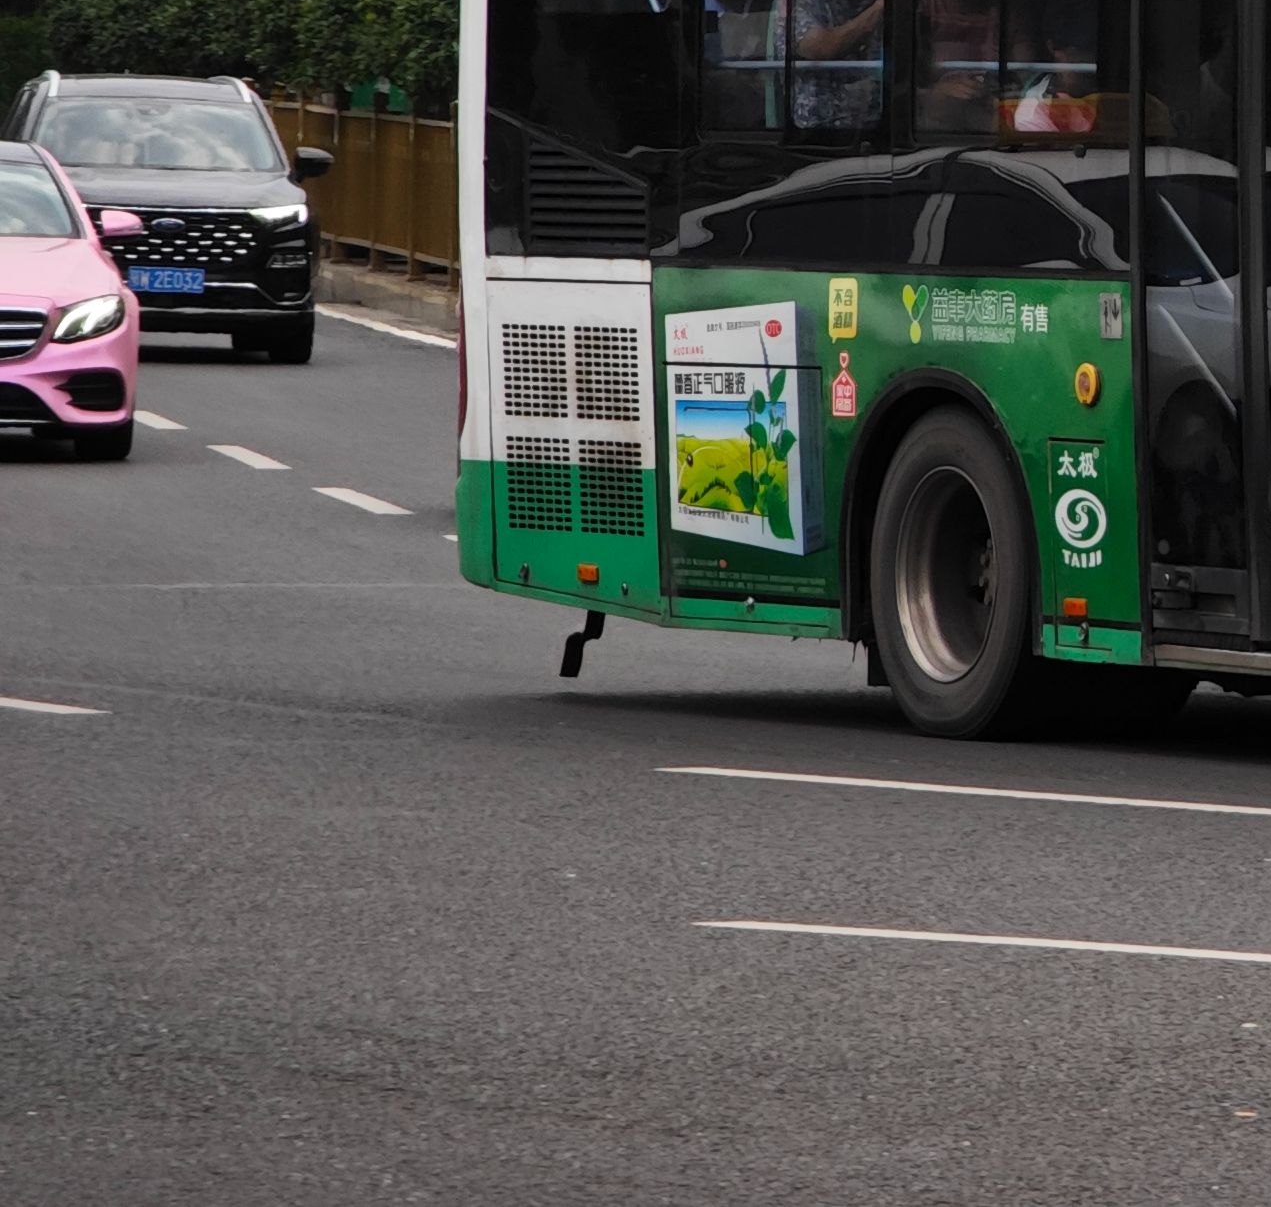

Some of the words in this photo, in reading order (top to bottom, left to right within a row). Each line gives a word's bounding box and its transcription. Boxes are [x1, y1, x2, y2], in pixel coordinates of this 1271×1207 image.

[931, 288, 1016, 324] 益丰大药房
[1020, 303, 1049, 334] 有售
[1057, 450, 1098, 478] 太极
[1062, 549, 1102, 568] TAIJI
